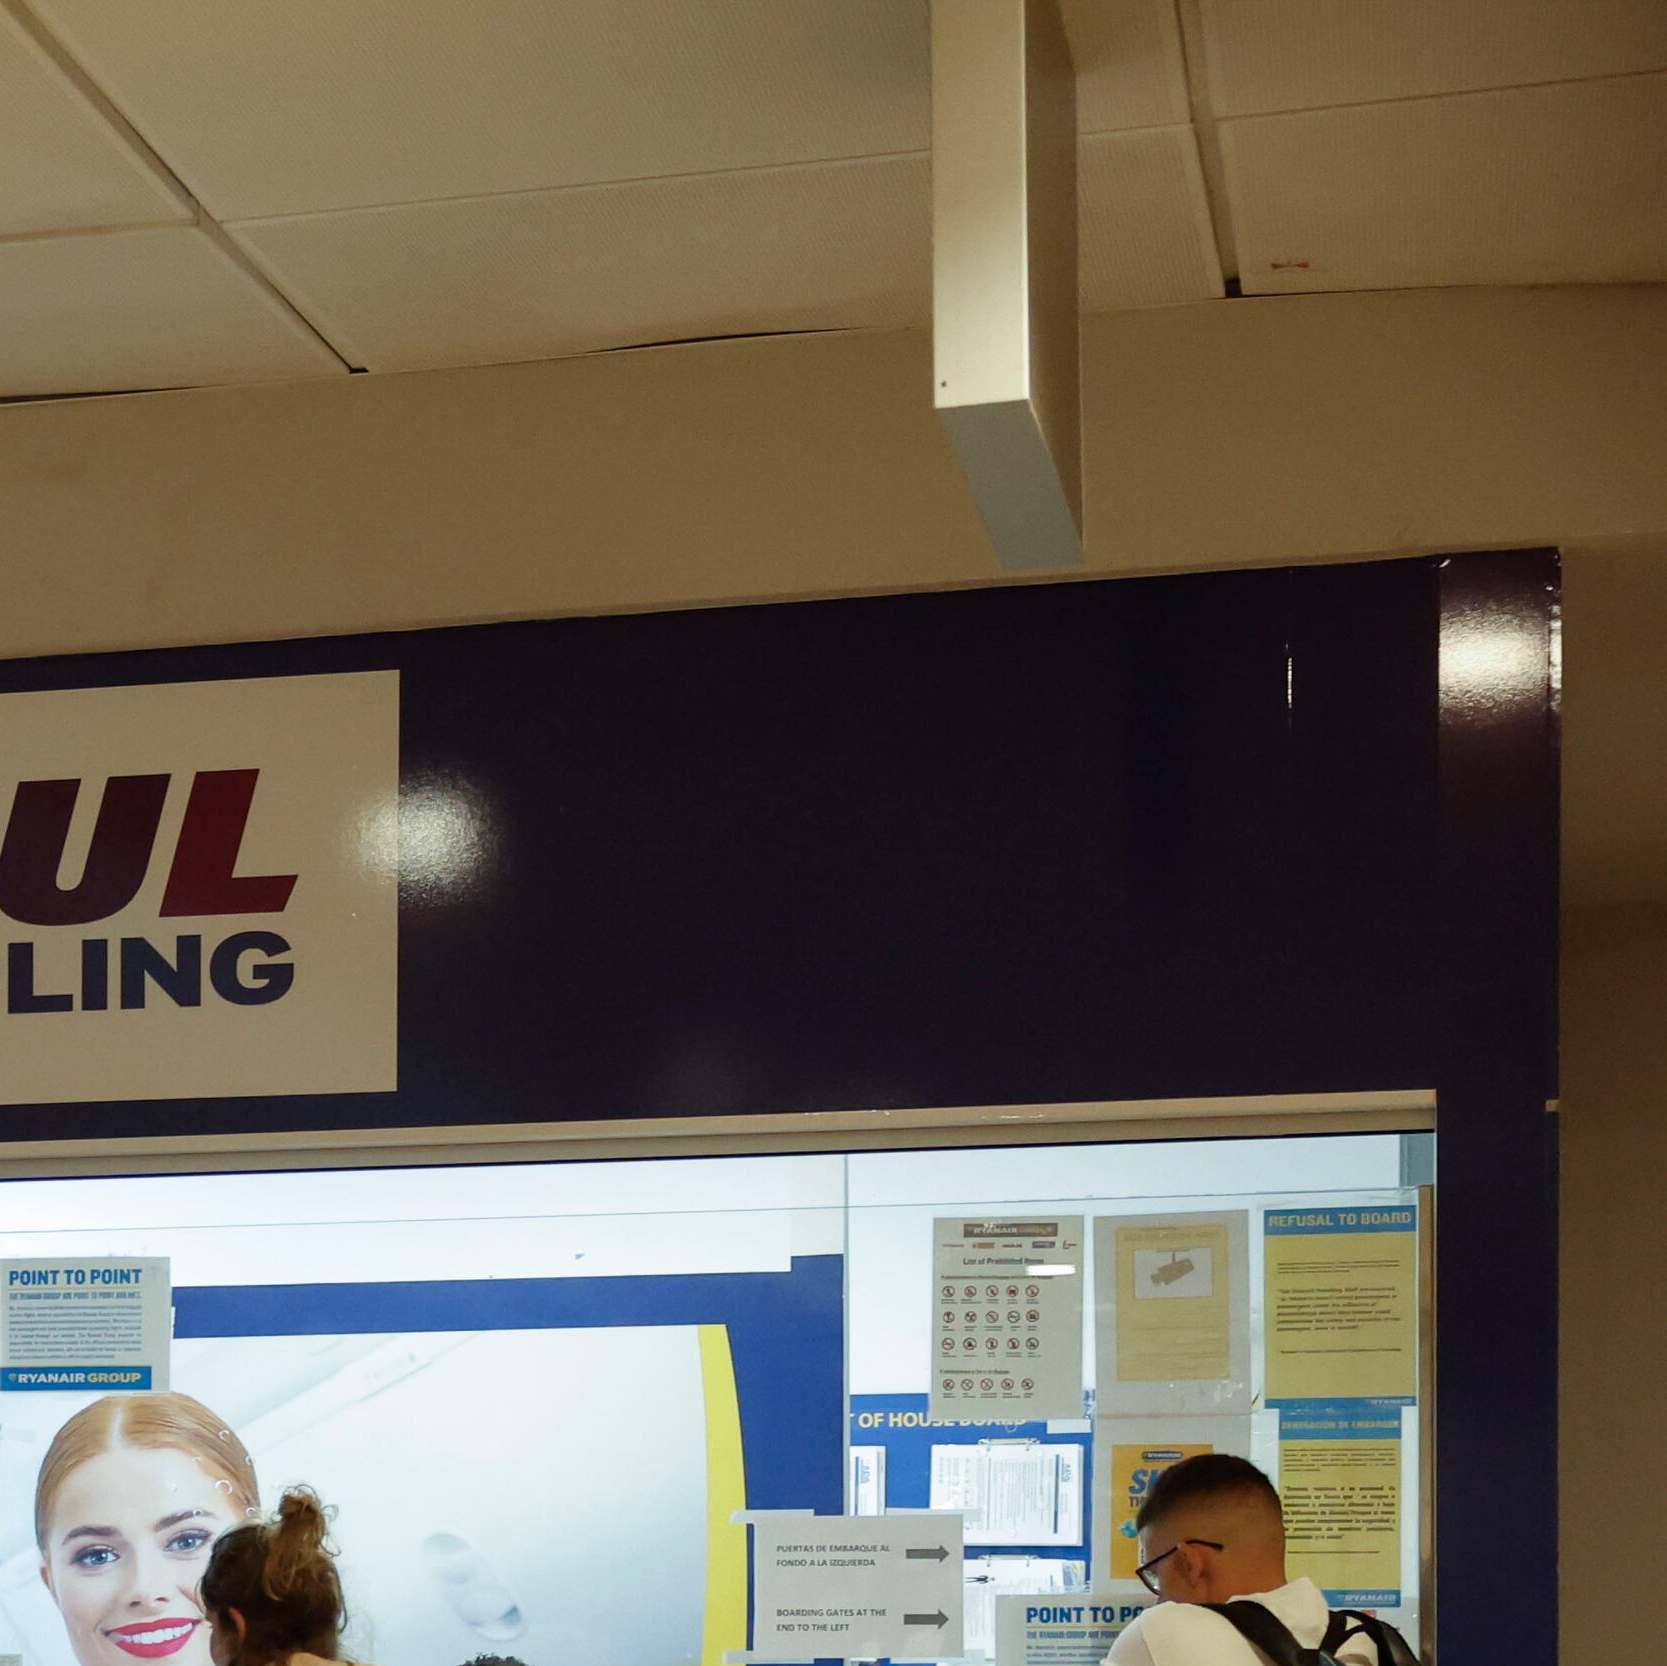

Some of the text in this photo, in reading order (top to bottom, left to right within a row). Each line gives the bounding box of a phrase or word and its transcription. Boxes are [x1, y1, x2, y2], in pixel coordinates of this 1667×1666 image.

[1268, 1211, 1411, 1227] REFUSAL TO BOARD
[9, 1268, 142, 1285] POINT TO POINT
[18, 1372, 142, 1383] RYANAIR GROUP
[858, 1413, 884, 1428] OF
[1026, 1607, 1084, 1623] POINT
[1089, 1607, 1115, 1623] TO
